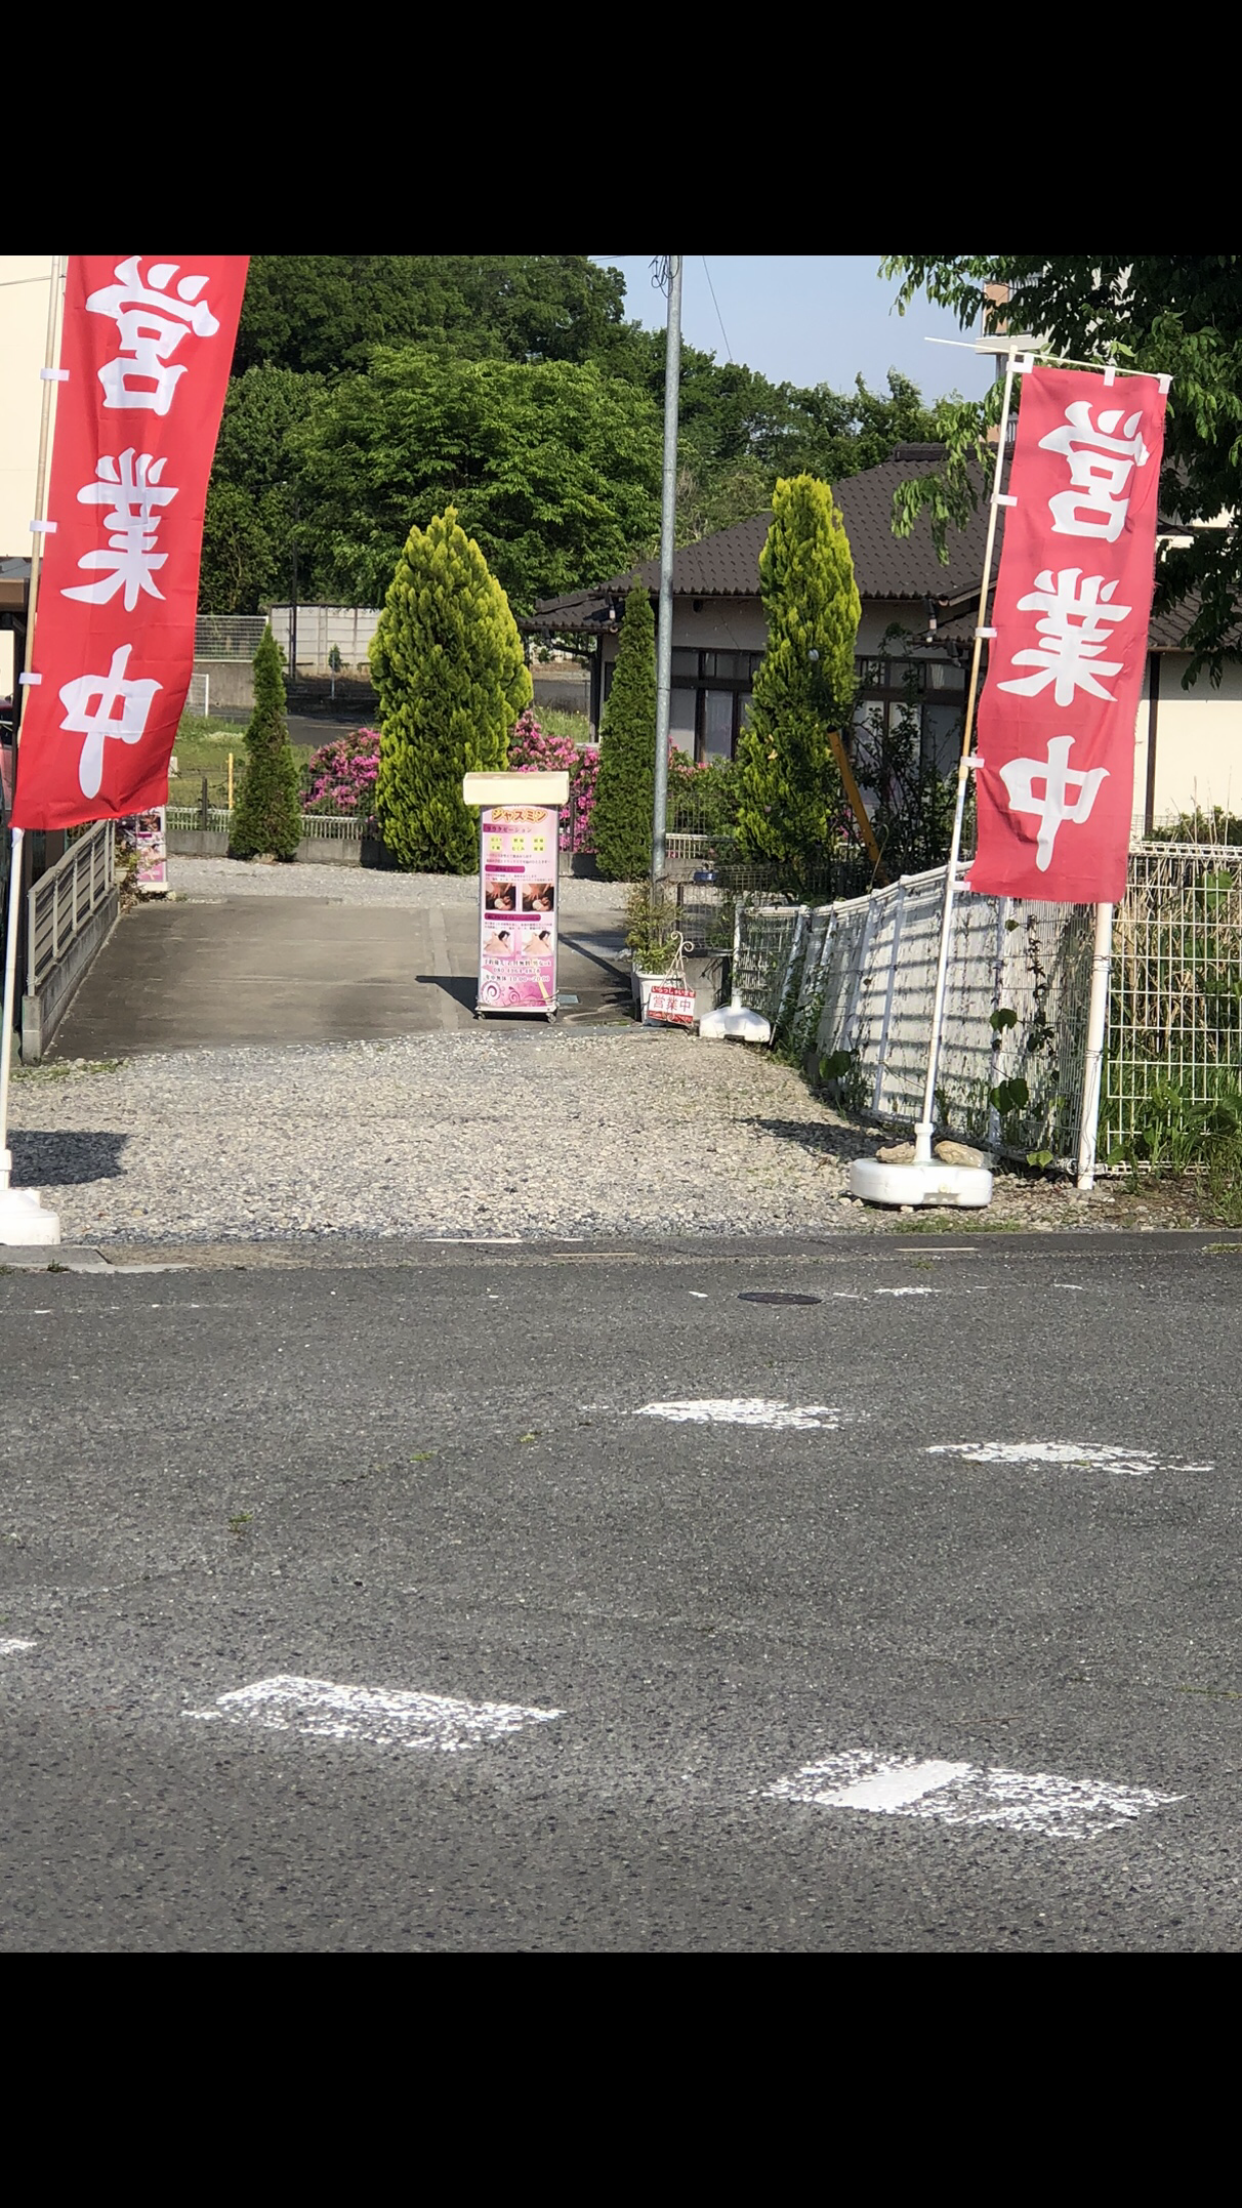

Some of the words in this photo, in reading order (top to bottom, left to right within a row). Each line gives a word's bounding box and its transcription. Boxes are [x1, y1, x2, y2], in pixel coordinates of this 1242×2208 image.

[59, 256, 220, 800] 営業中
[997, 400, 1149, 872] 営業中
[492, 808, 548, 822] ジャスミン
[653, 994, 692, 1012] 営業中
